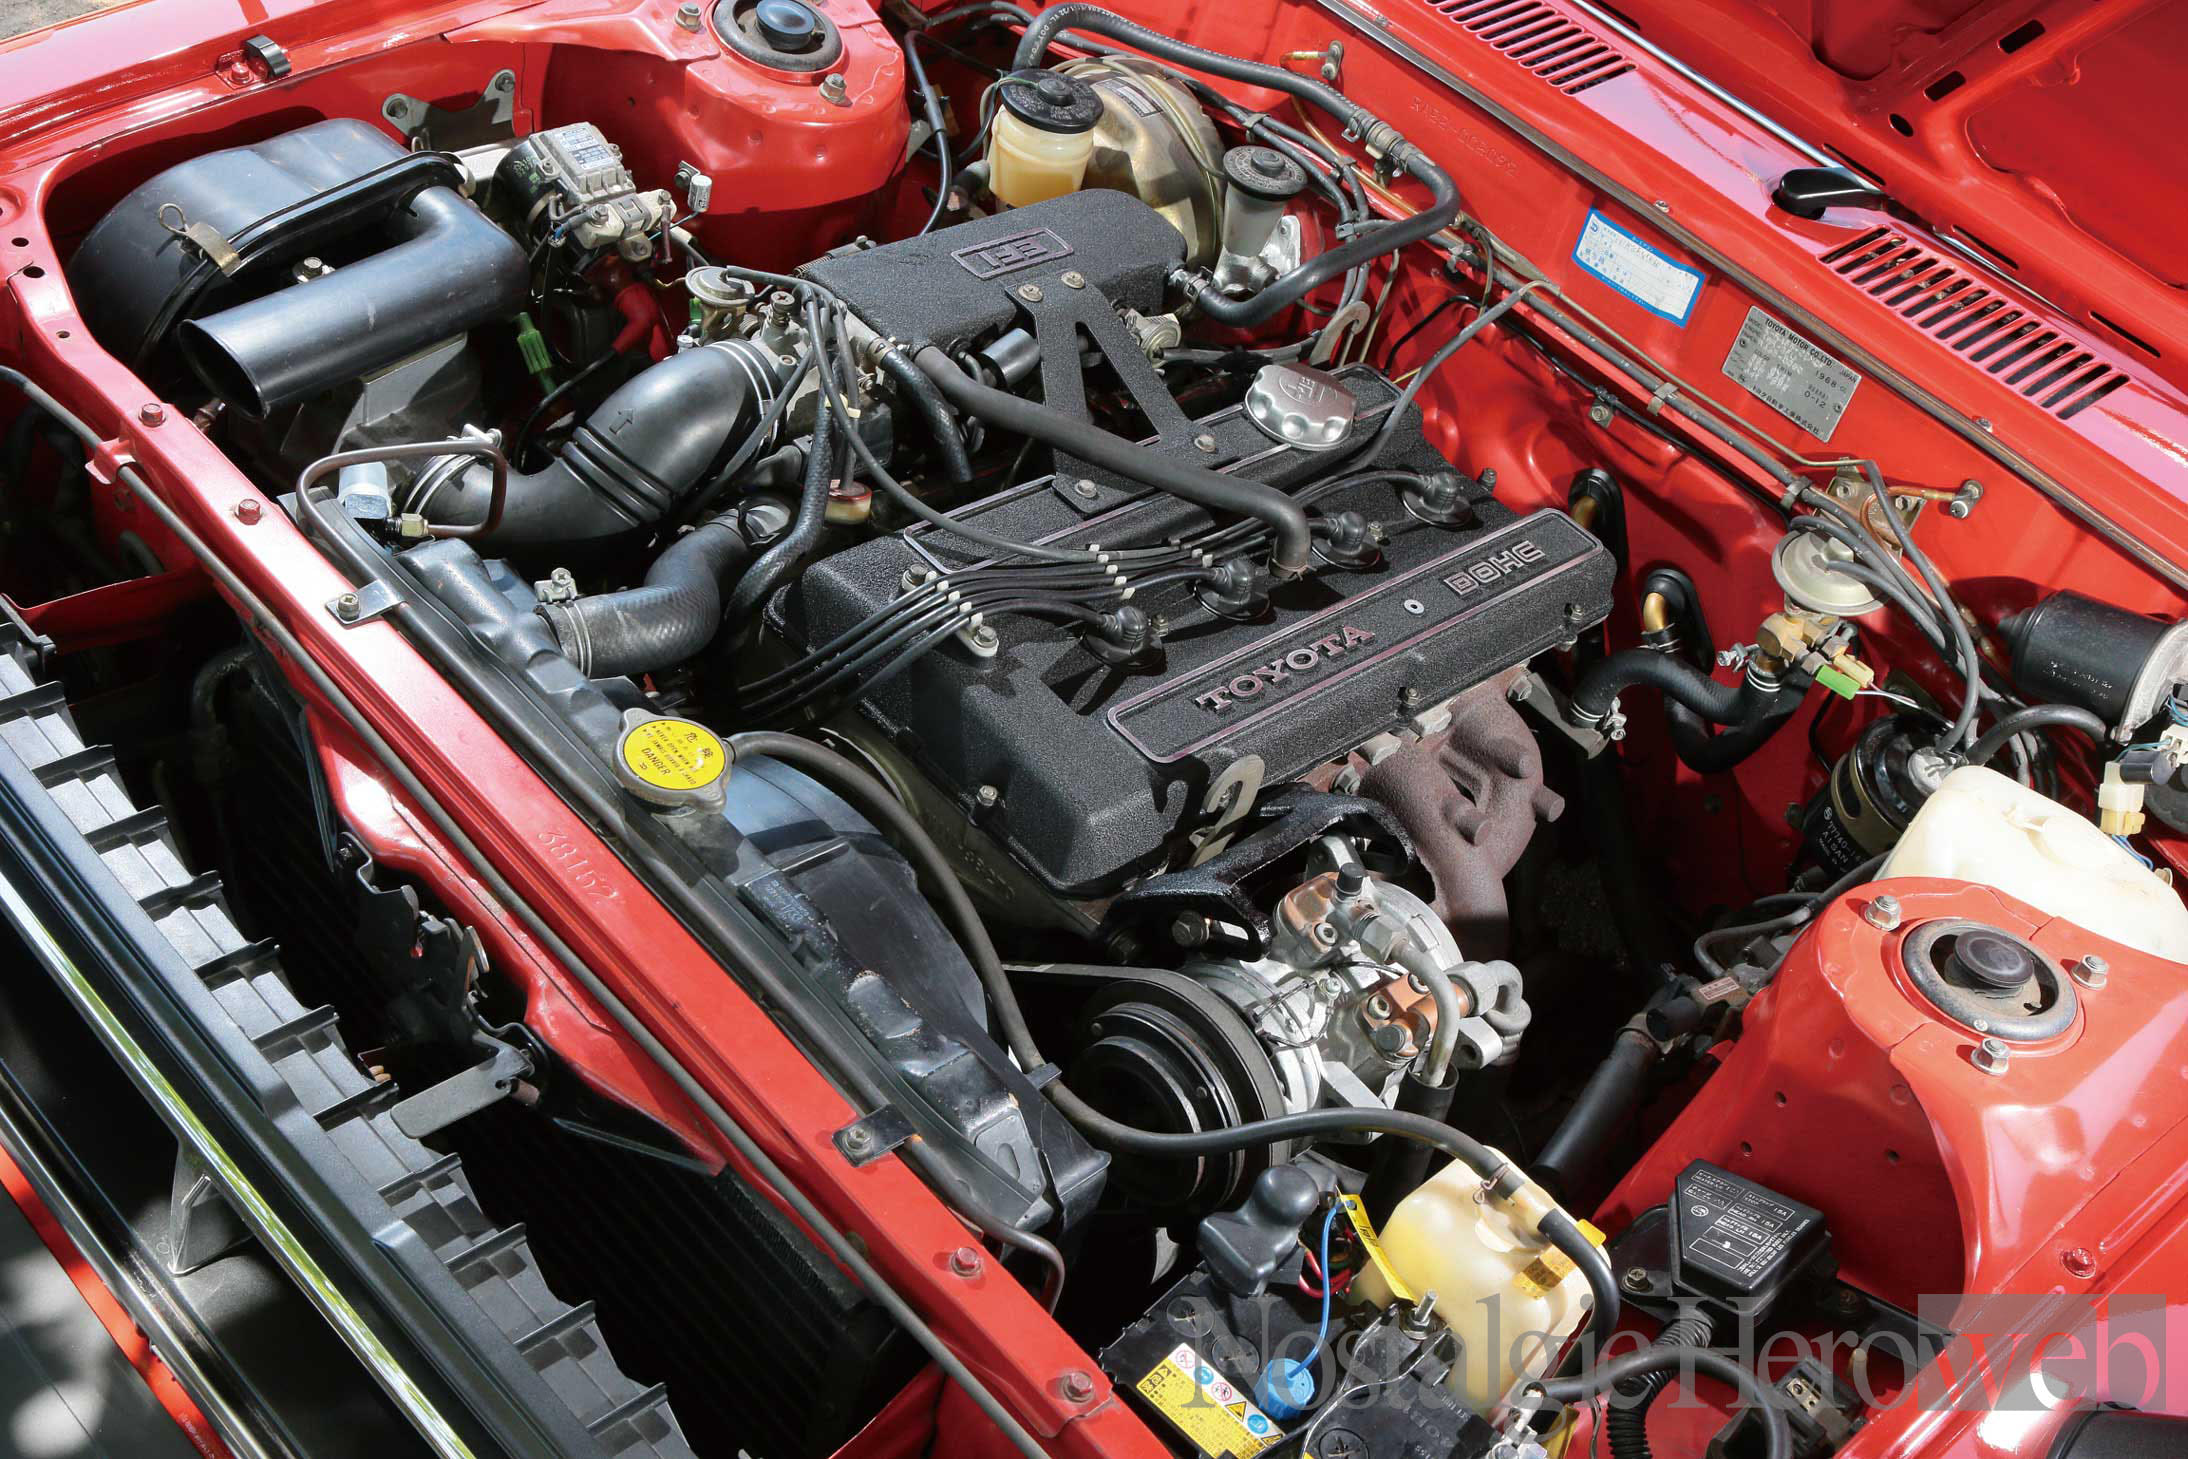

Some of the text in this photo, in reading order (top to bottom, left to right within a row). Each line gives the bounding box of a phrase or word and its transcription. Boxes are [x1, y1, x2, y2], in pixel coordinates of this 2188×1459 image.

[1764, 318, 1787, 337] TOYOTA
[1788, 333, 1809, 351] MOTOR
[1815, 370, 1837, 389] 1968
[1443, 540, 1546, 596] DOHC
[1195, 625, 1376, 711] TOYOTA
[642, 747, 671, 775] DANGER
[1822, 831, 1849, 864] AISAN
